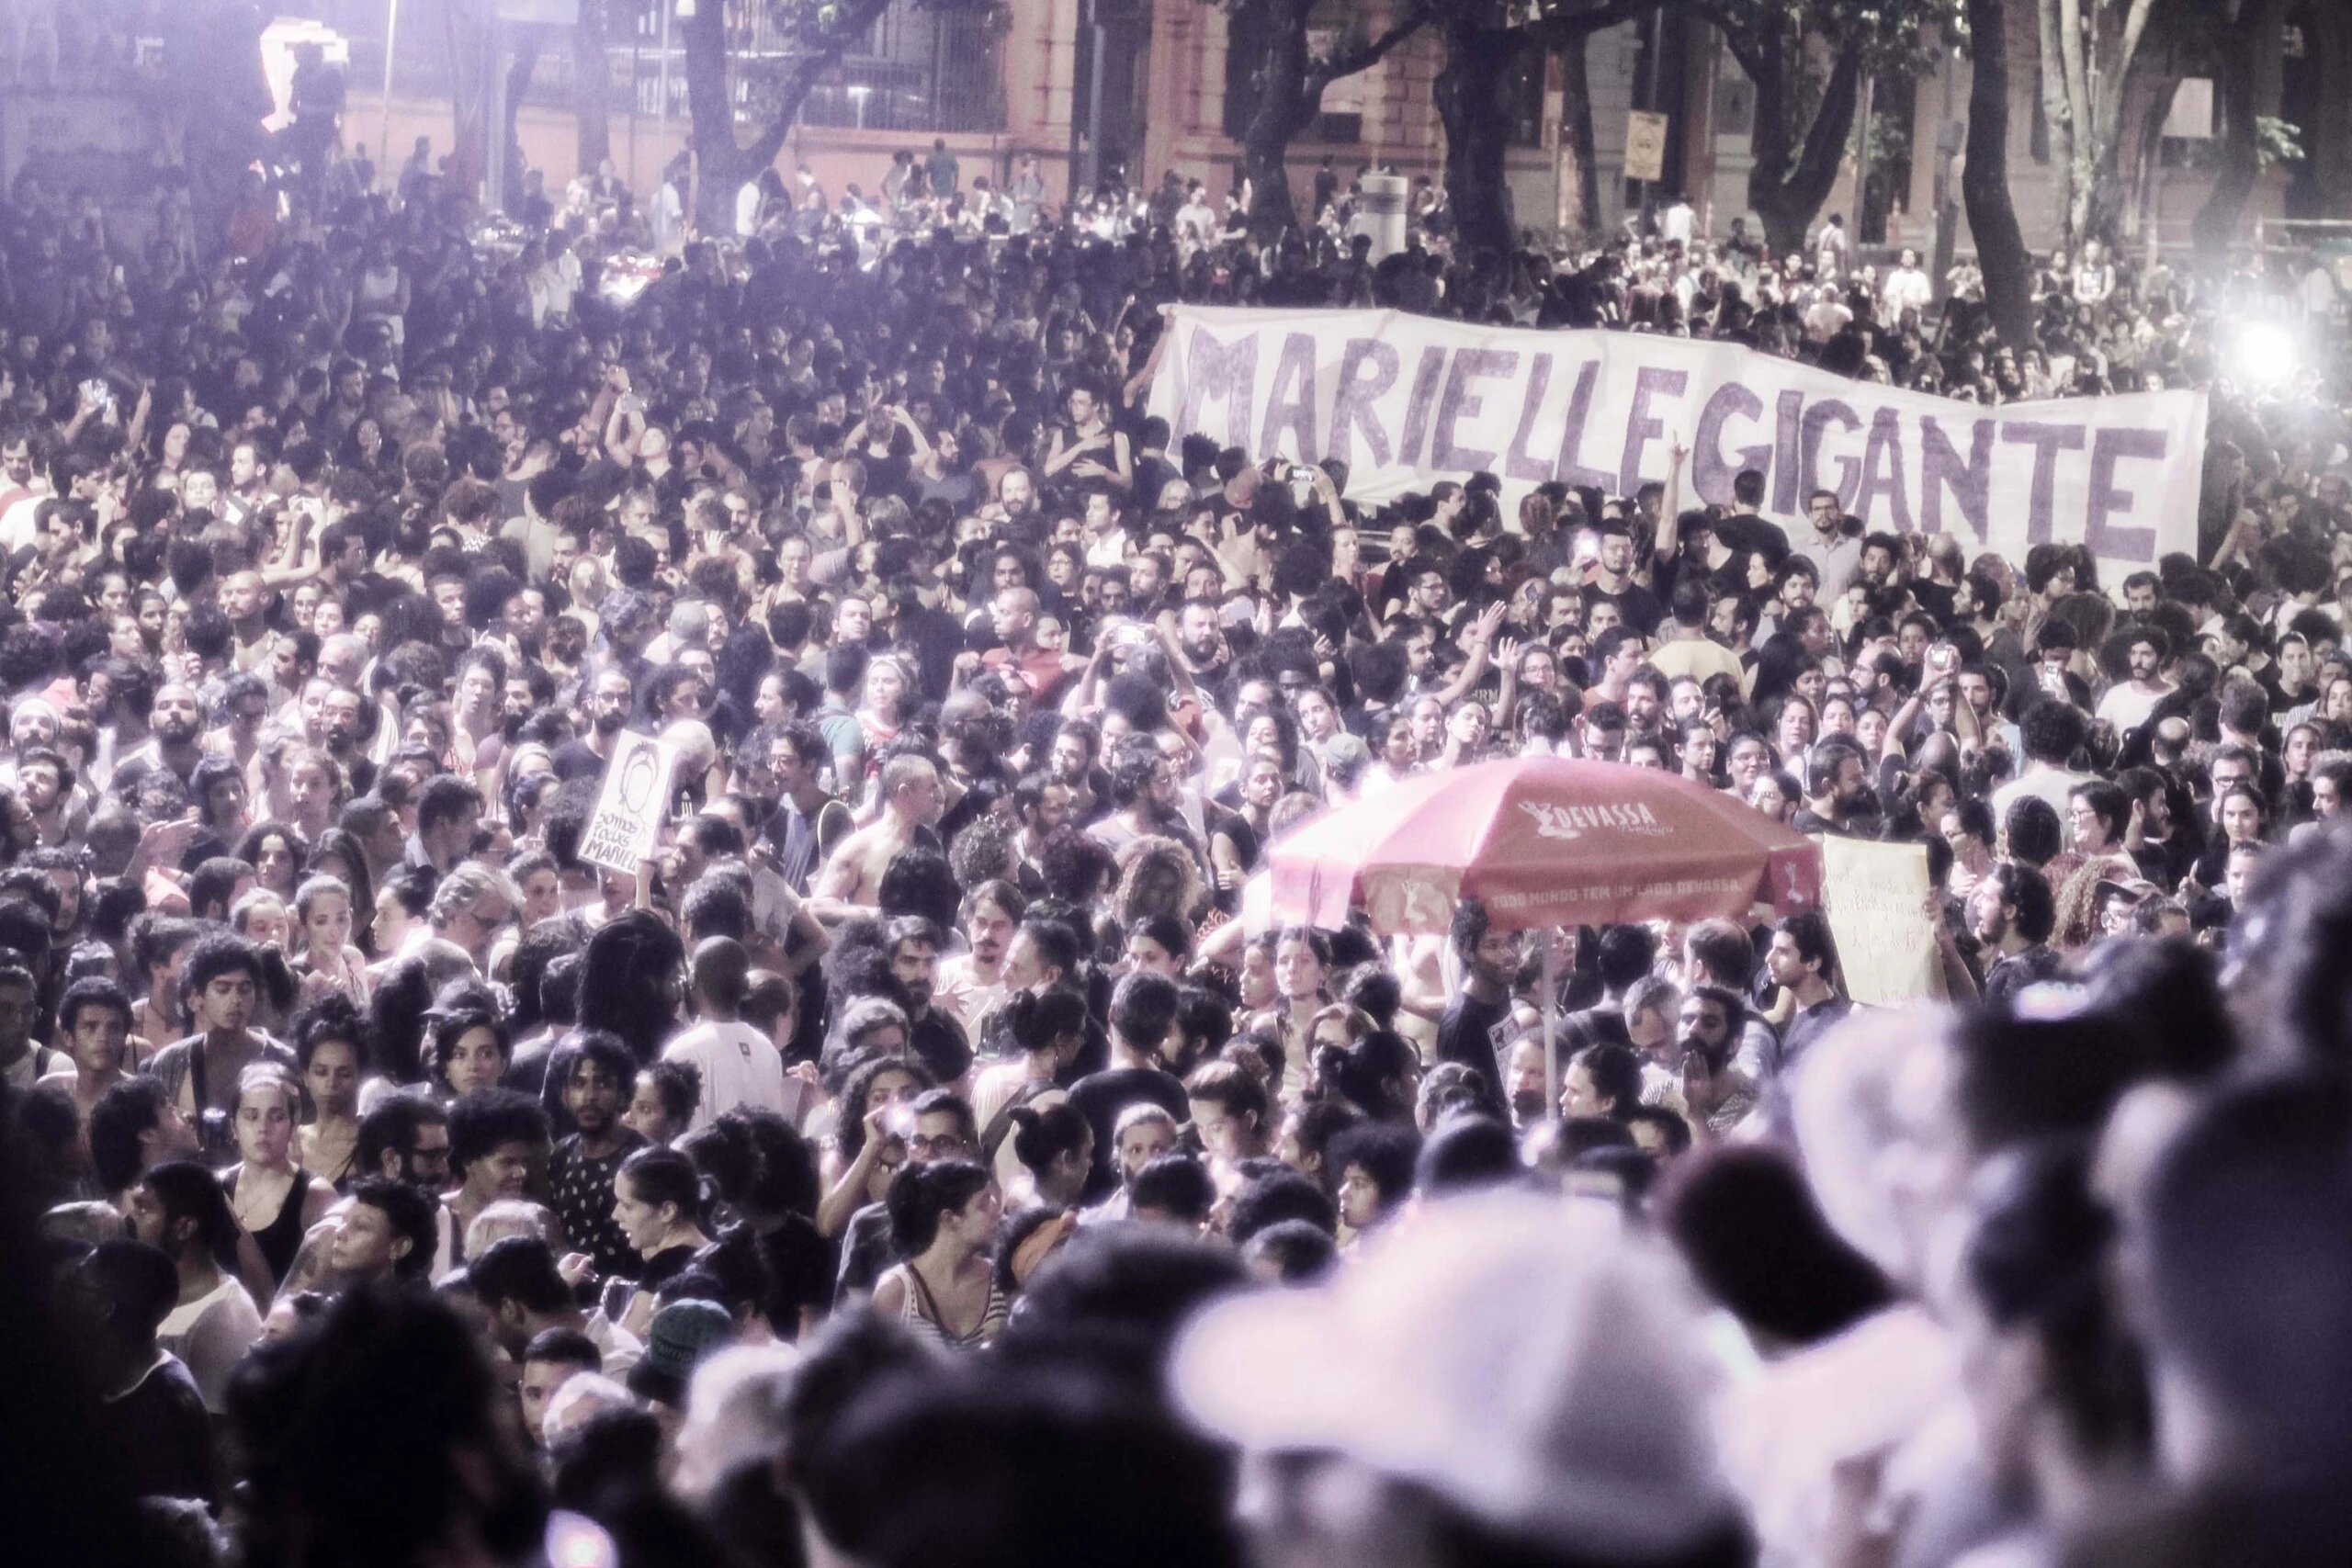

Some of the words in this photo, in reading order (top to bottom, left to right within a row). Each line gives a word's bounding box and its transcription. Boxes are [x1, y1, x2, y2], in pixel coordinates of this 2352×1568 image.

[1173, 325, 1688, 498] MARIELLE
[1692, 381, 2167, 562] GIGANTE
[1554, 802, 1657, 829] DEVASSA
[1492, 893, 1526, 908] TODO
[1530, 888, 1577, 905] MUNDO
[1582, 886, 1611, 900] TEM
[1613, 884, 1634, 897] UM
